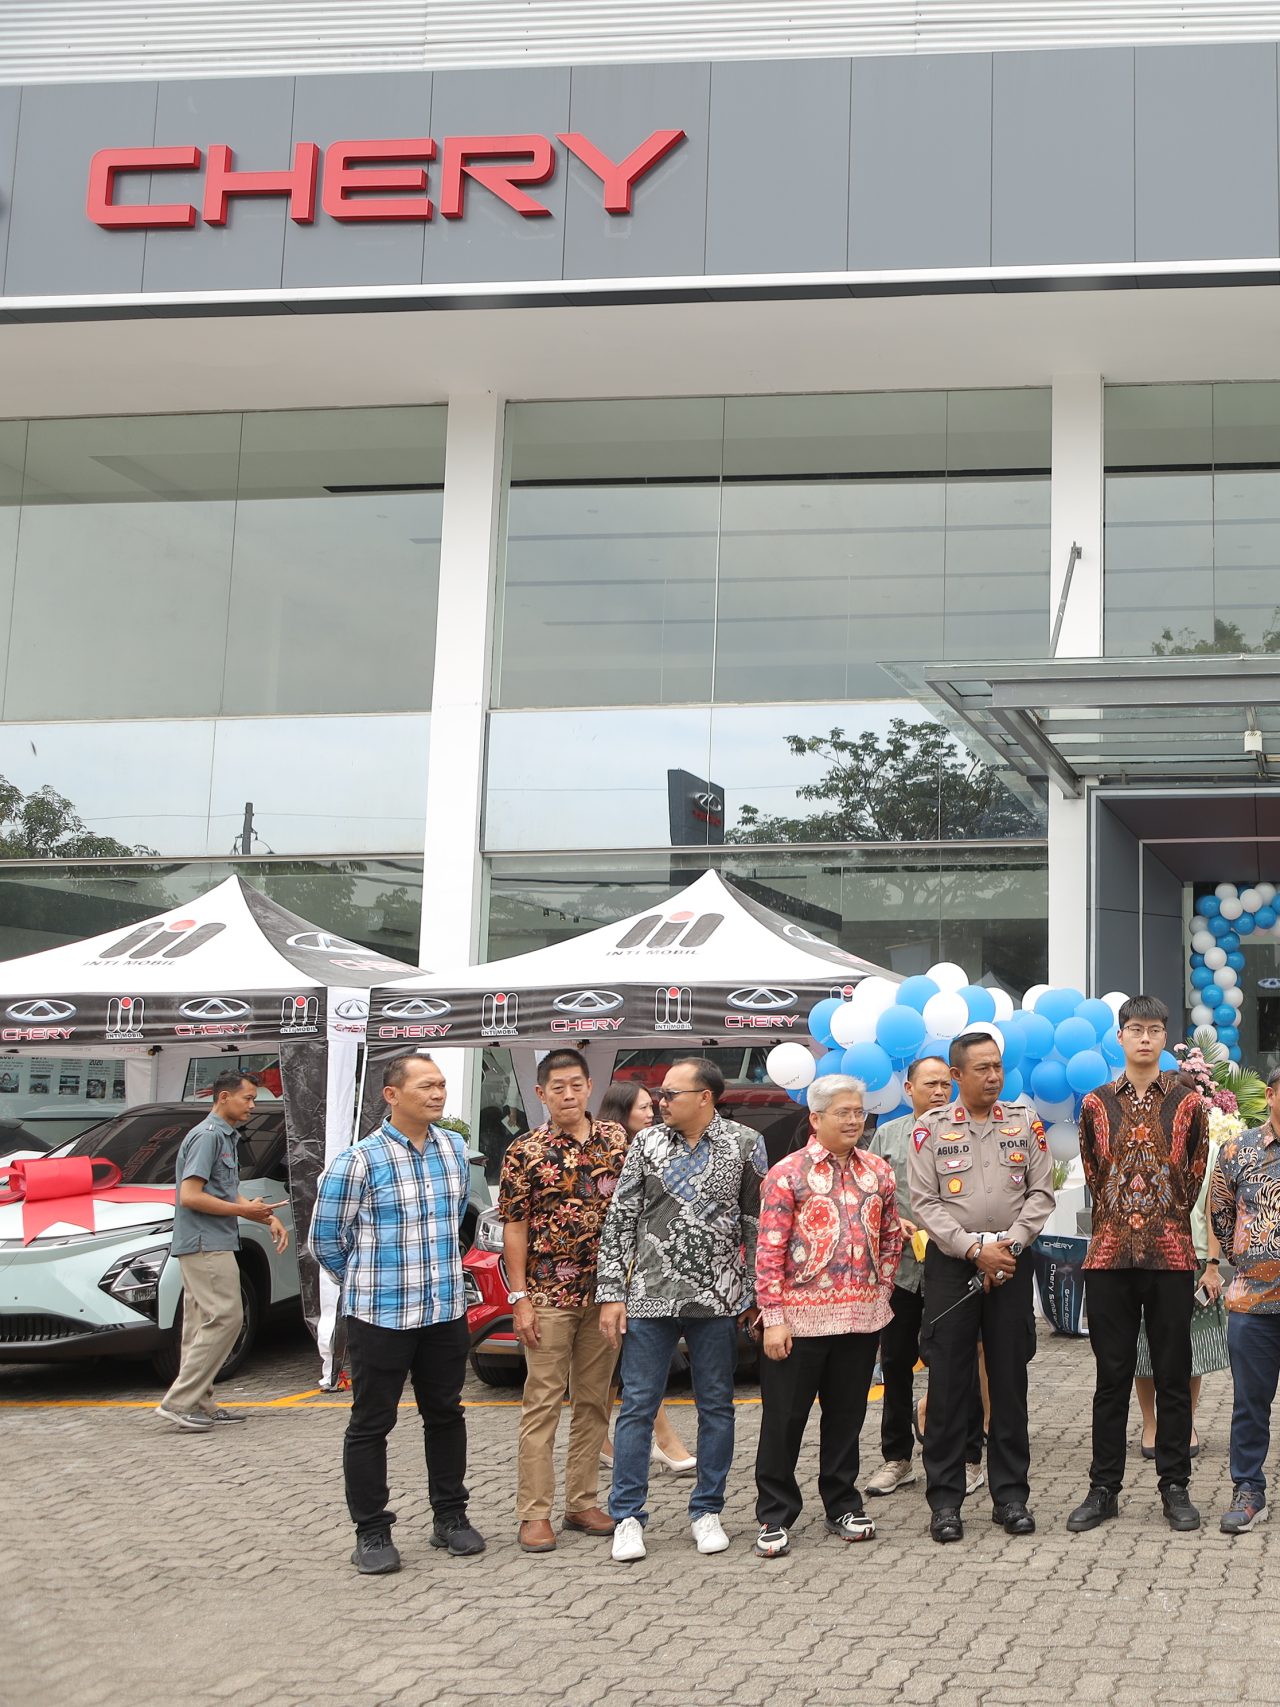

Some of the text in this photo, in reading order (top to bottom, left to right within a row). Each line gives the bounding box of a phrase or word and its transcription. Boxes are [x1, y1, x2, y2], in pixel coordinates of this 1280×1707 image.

[86, 129, 687, 229] CHERY
[551, 1017, 625, 1032] CHERY
[725, 1014, 799, 1028] CHERY
[2, 1027, 77, 1040] CHERY
[175, 1024, 249, 1036] CHERY
[335, 1024, 366, 1034] CHER
[379, 1024, 452, 1039] CHERY
[937, 1145, 970, 1156] AGUS.D
[1000, 1140, 1028, 1149] POLRI
[1043, 1241, 1074, 1250] CHERY
[1048, 1263, 1057, 1292] Chery
